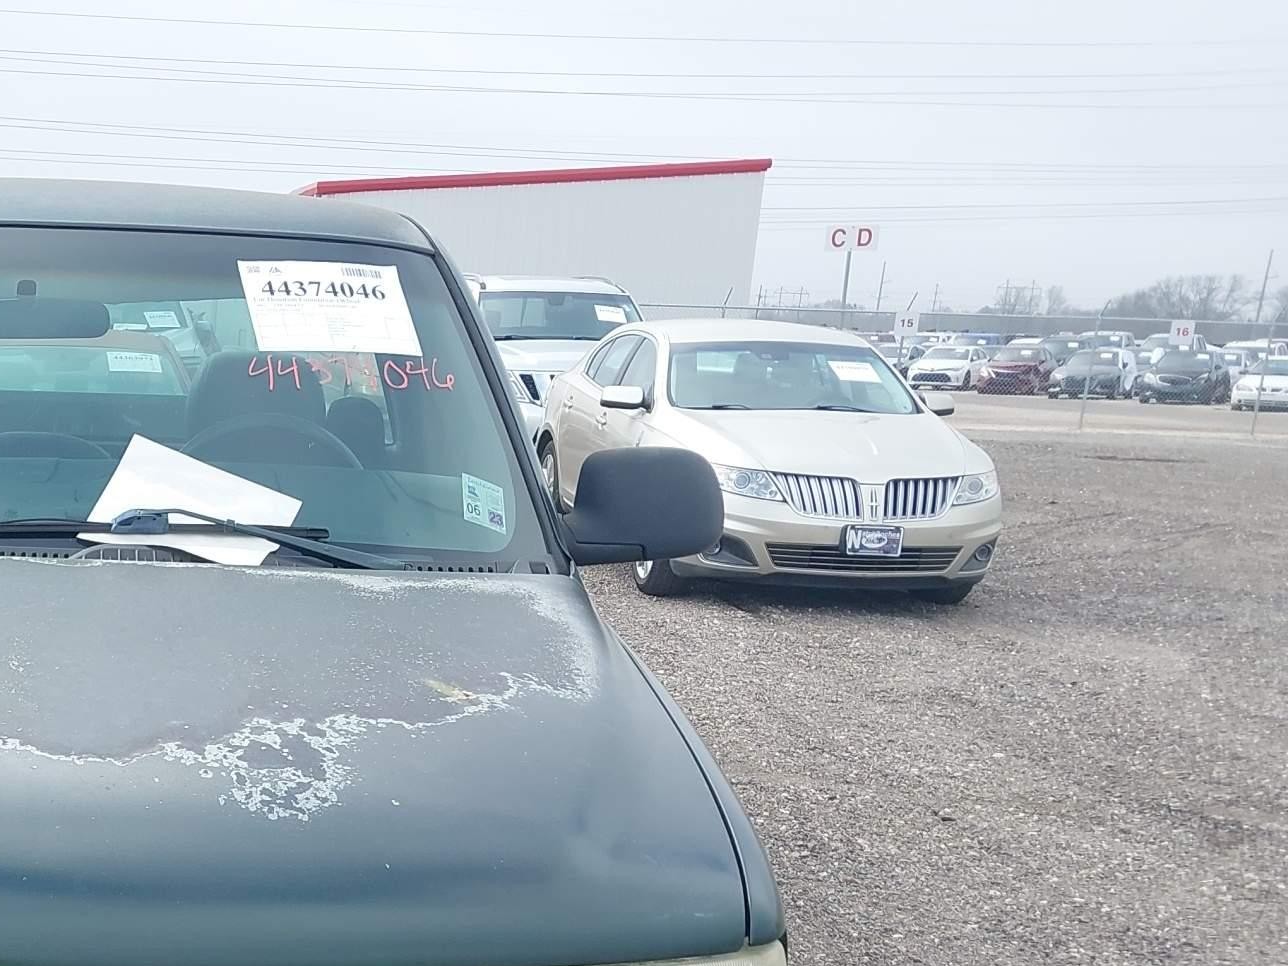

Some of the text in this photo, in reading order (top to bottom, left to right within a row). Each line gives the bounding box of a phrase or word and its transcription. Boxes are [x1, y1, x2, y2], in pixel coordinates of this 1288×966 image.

[831, 228, 873, 248] C D
[261, 280, 386, 301] 44374046
[900, 318, 914, 328] 15
[1176, 327, 1189, 337] 16
[248, 354, 455, 392] 4437046
[466, 502, 481, 517] 06
[488, 510, 505, 527] 23
